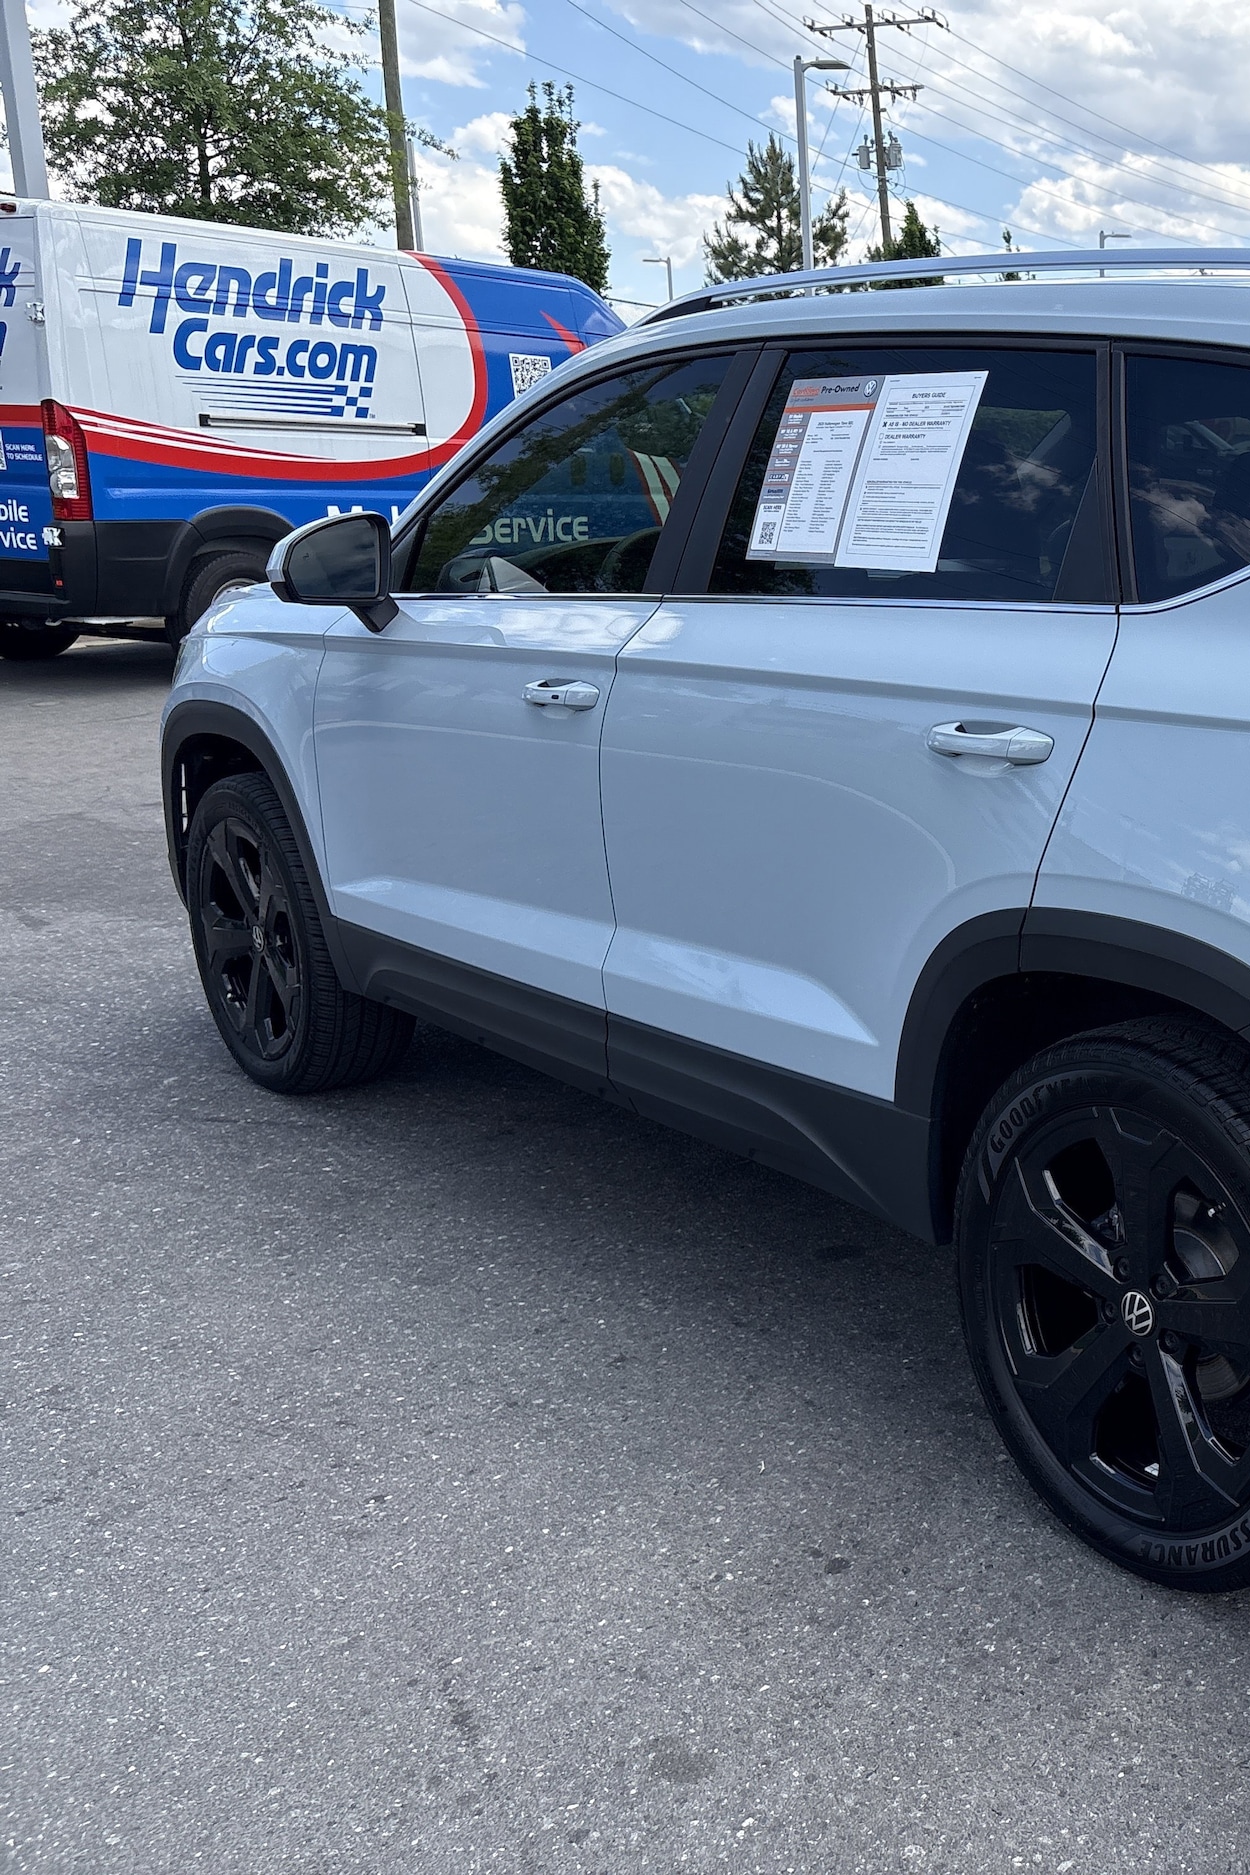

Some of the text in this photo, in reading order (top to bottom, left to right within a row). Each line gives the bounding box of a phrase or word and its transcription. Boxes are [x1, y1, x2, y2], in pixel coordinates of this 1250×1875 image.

[118, 238, 386, 333] Hendrick
[173, 317, 378, 383] Cars.com
[820, 383, 860, 394] Pre-Owned
[5, 443, 36, 452] SCAN HERE
[6, 452, 43, 462] TO SCHEDULE
